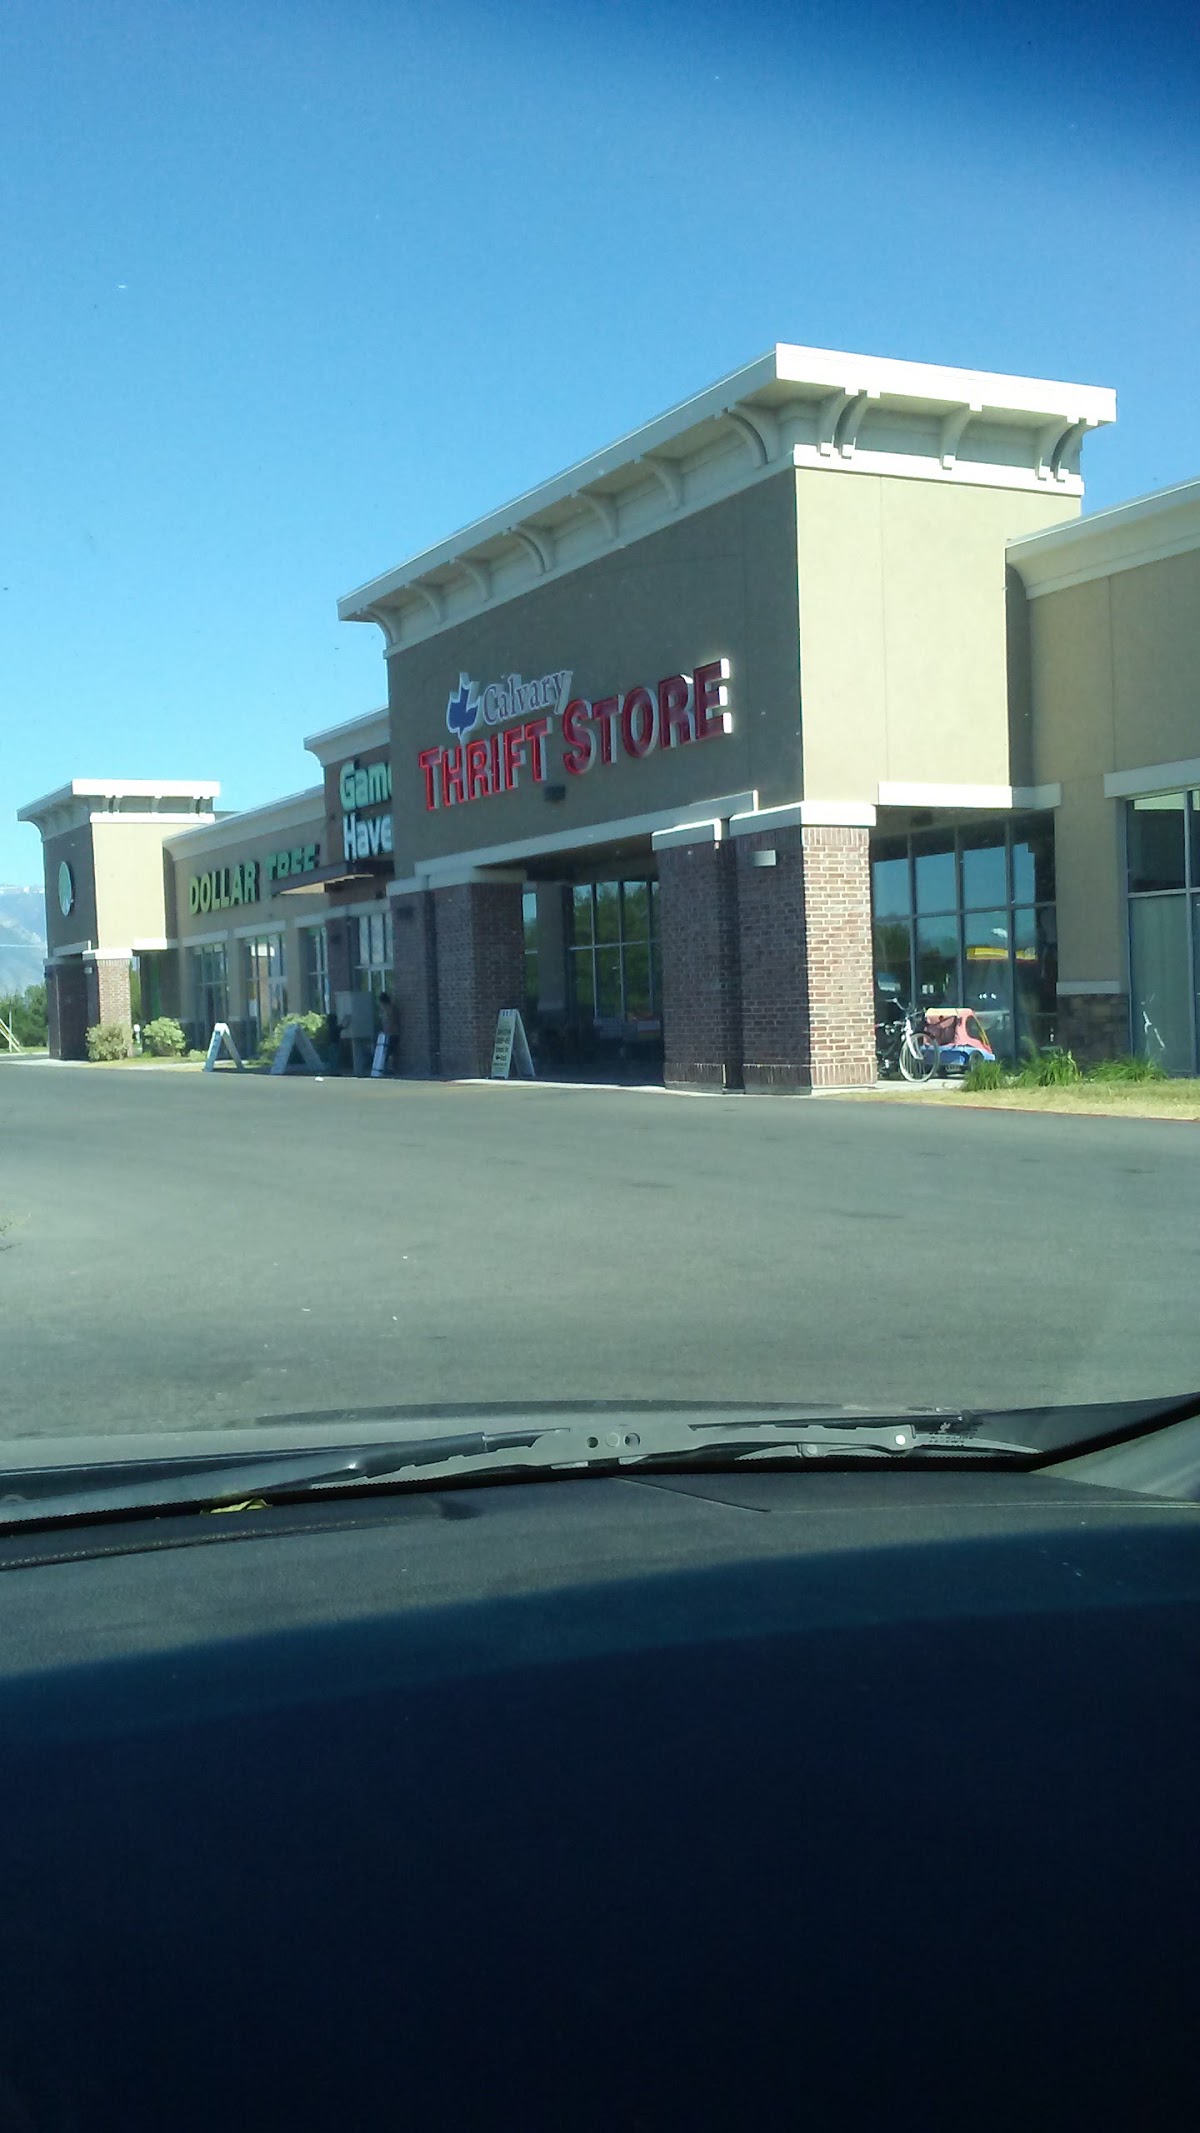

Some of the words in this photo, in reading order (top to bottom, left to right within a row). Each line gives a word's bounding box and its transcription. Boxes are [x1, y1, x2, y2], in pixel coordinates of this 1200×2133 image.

[480, 670, 573, 725] Calvary
[418, 717, 553, 811] THRIFT
[562, 657, 731, 776] STORE
[339, 761, 392, 811] Gam
[189, 861, 259, 915] DOLLAR
